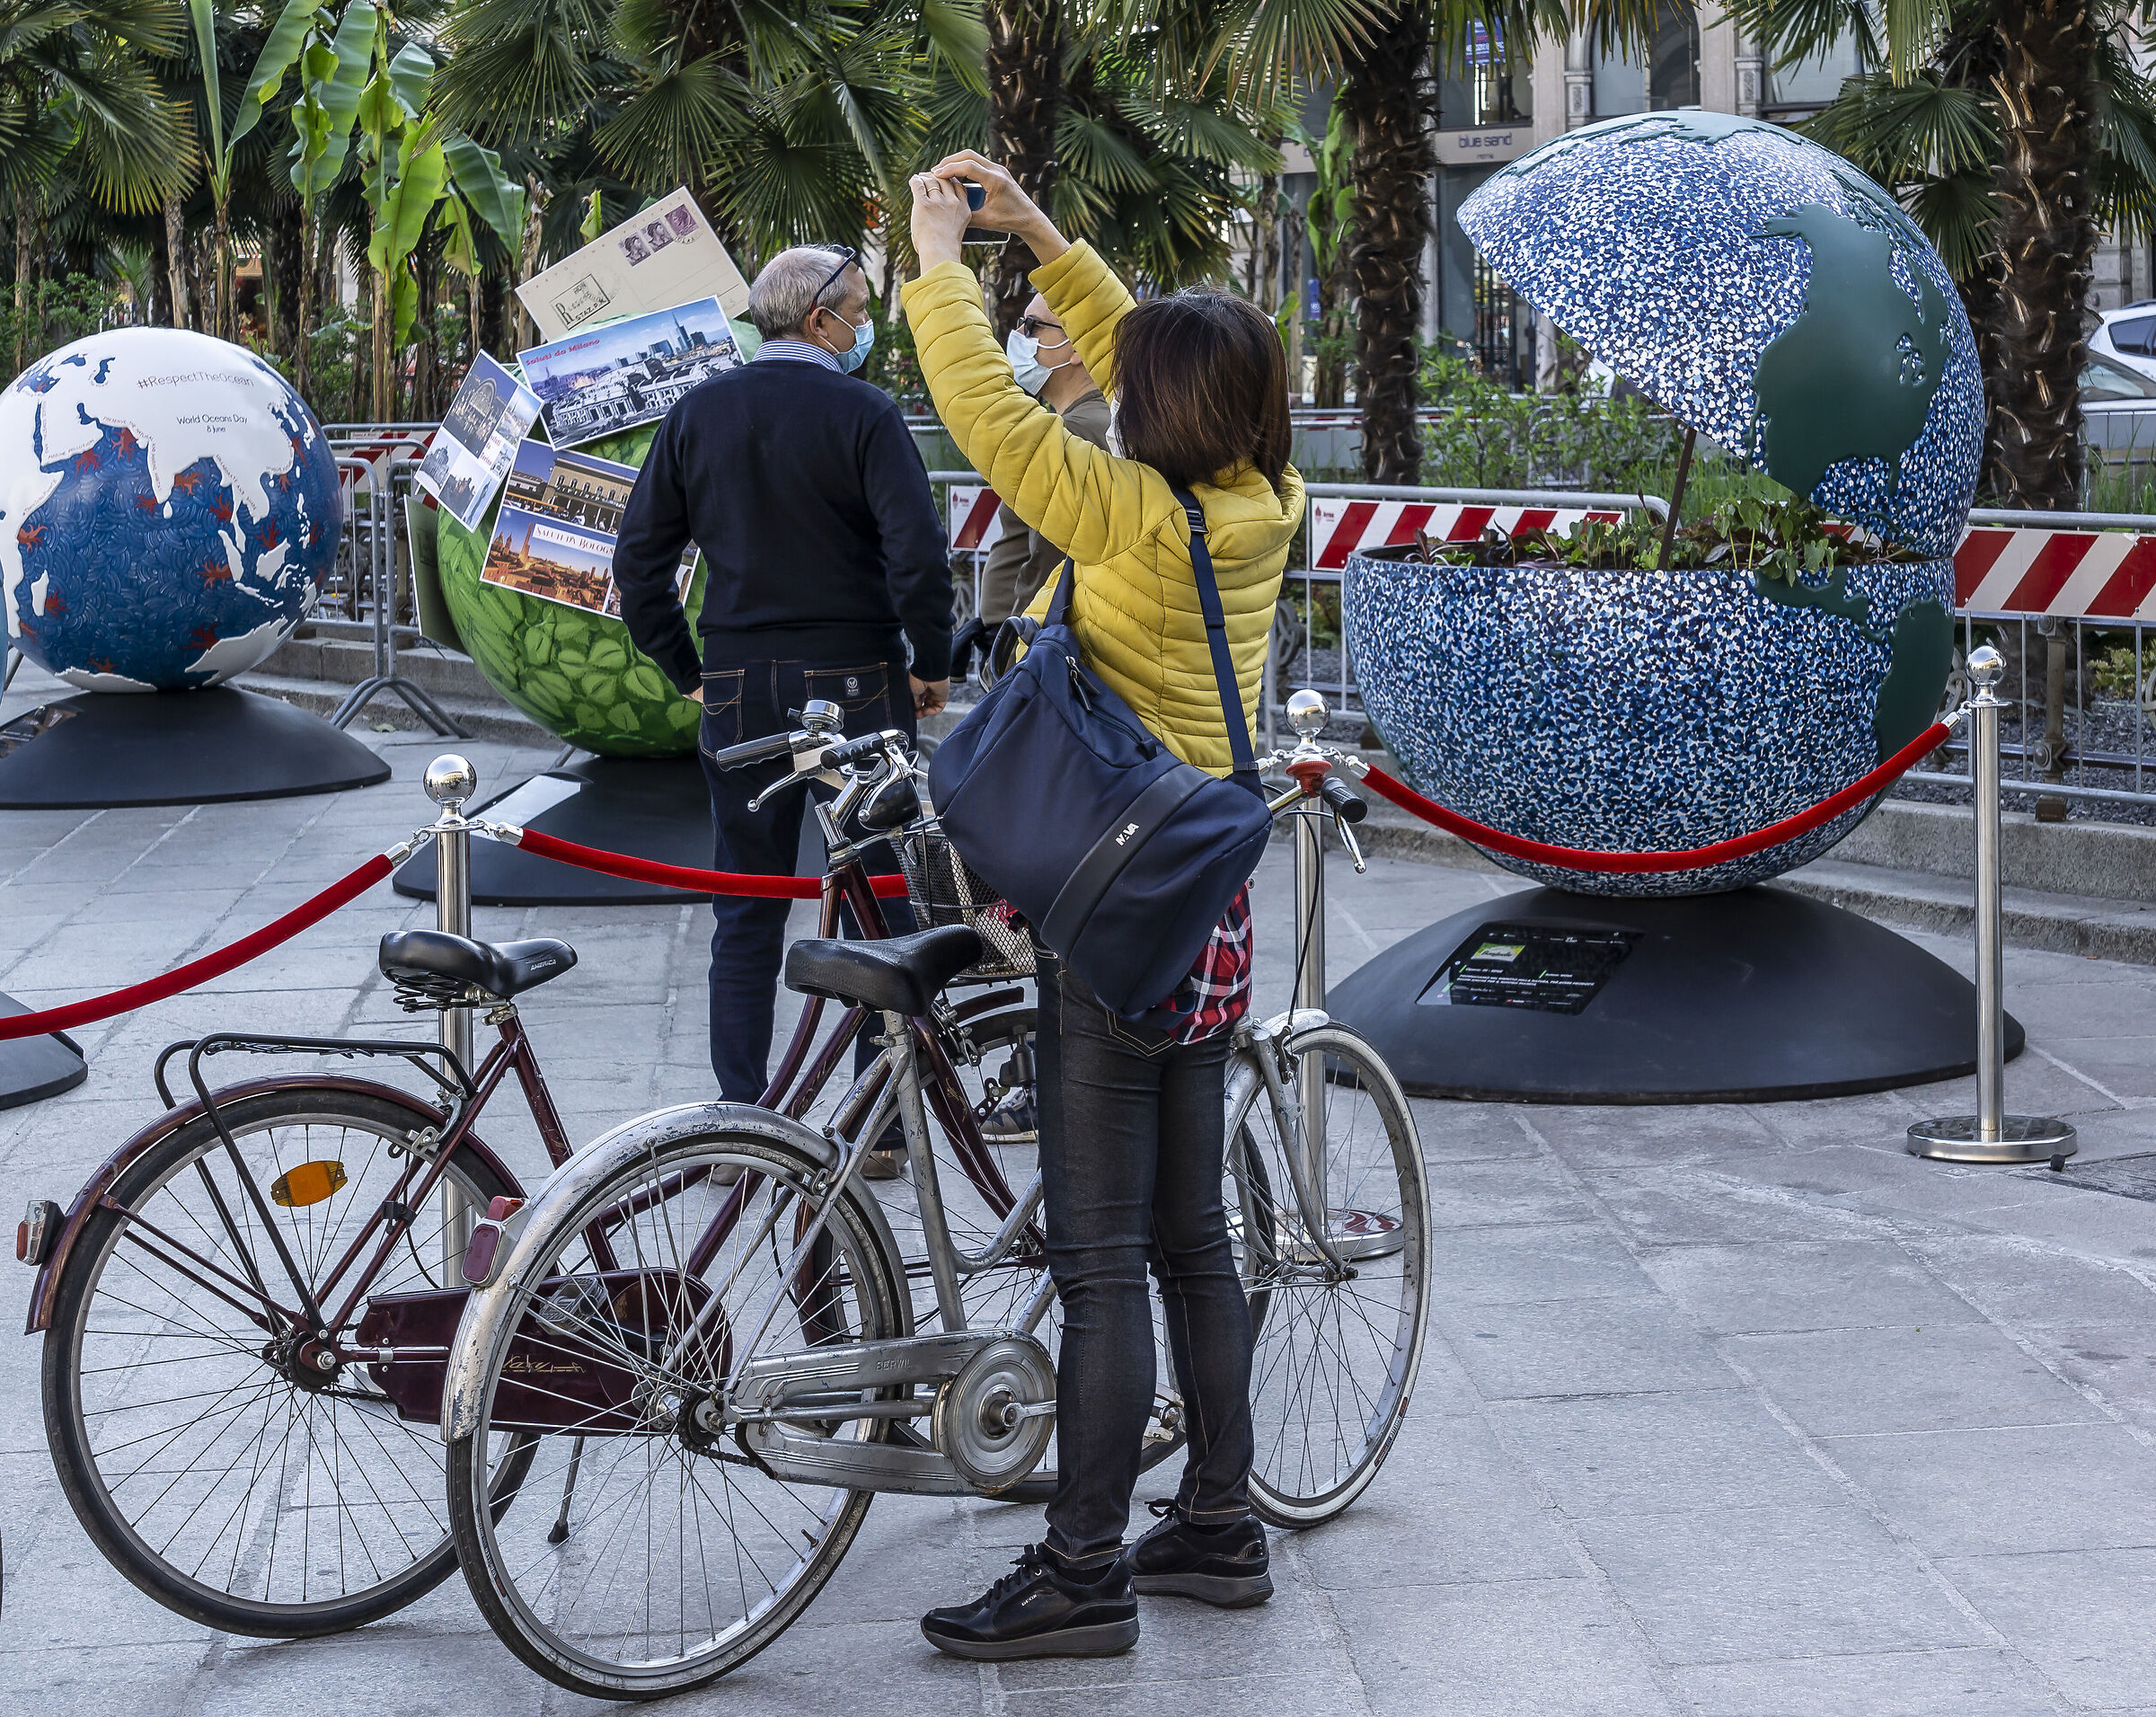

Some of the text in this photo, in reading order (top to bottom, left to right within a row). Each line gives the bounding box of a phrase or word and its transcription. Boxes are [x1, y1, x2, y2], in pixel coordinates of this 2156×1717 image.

[1459, 132, 1512, 147] blue sand
[526, 353, 552, 366] Saluti
[569, 340, 600, 352] Milano
[137, 371, 254, 389] #RespectTheOcean
[177, 414, 248, 424] World Oceans Day
[579, 538, 614, 555] BOLOGN
[1116, 823, 1139, 845] NAVA
